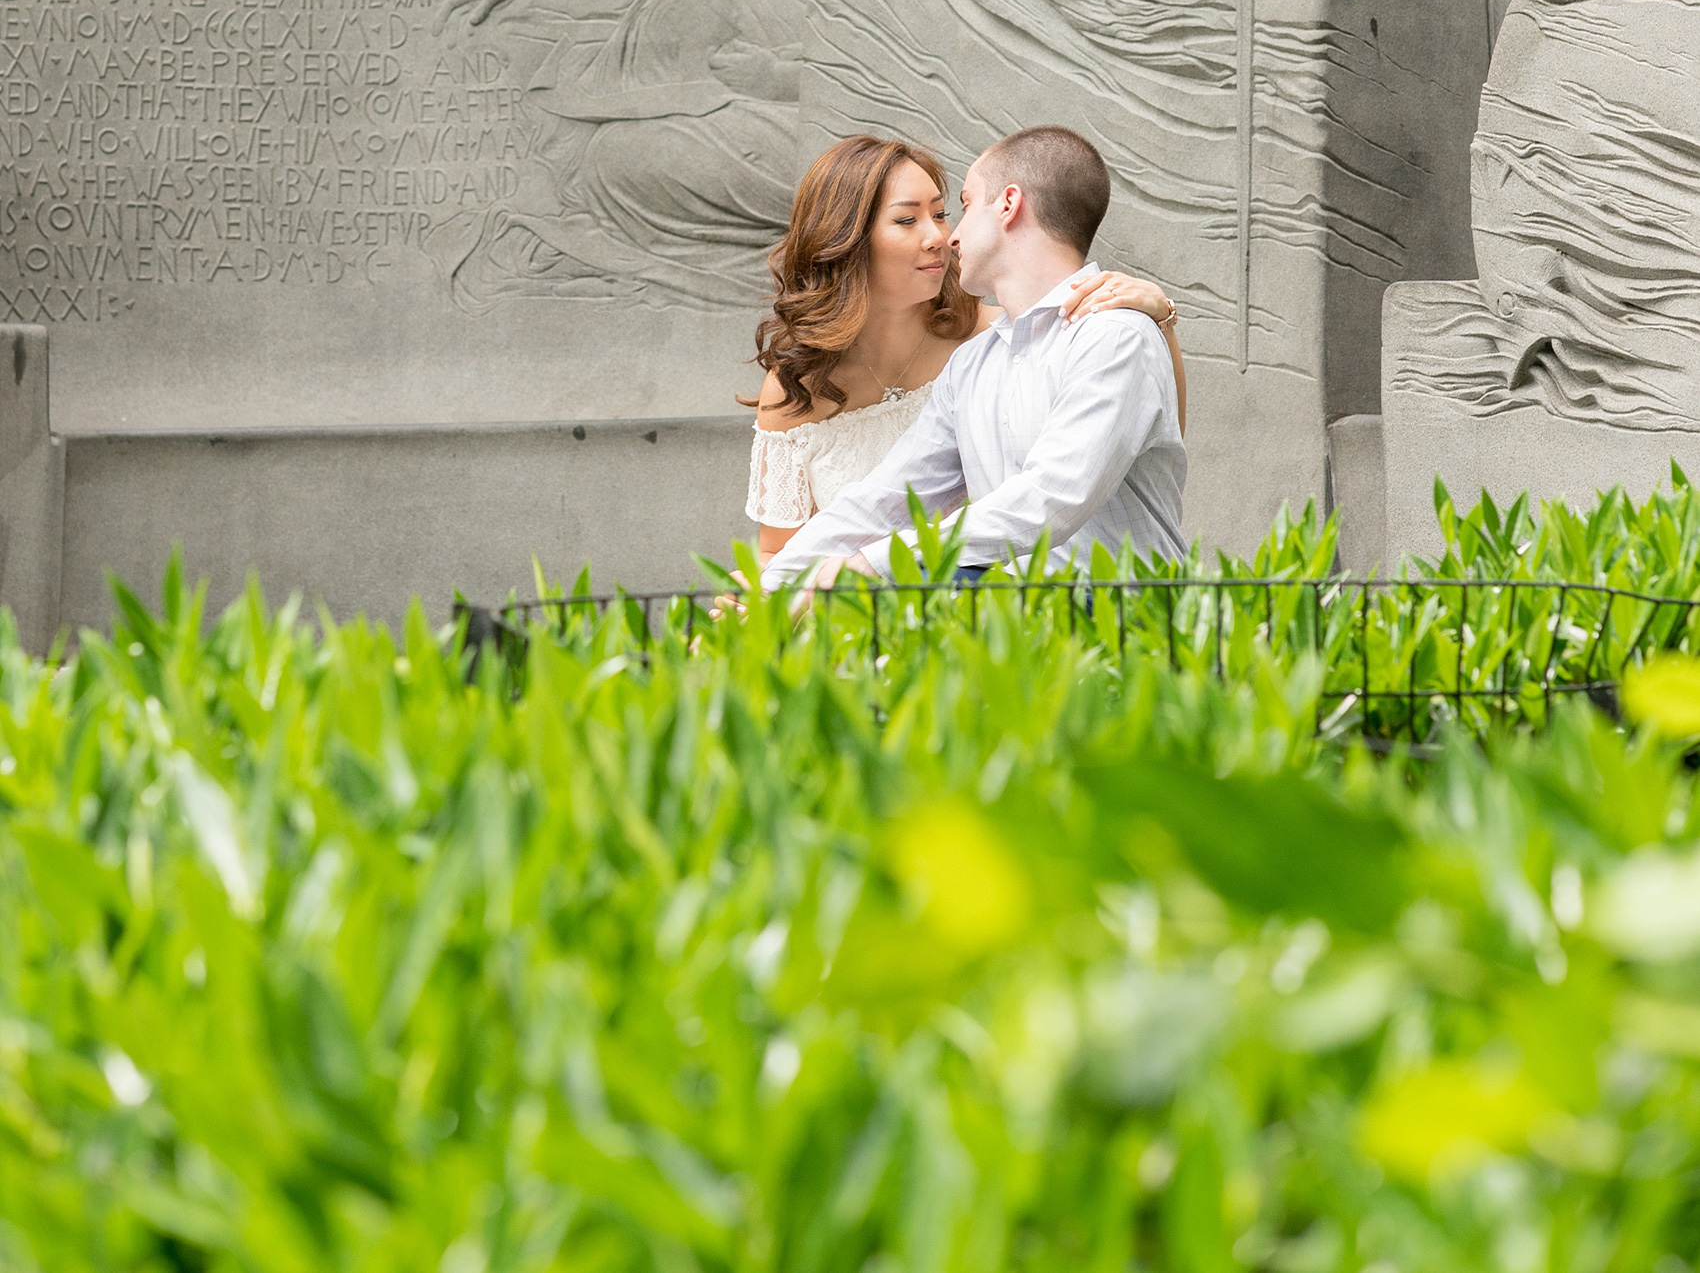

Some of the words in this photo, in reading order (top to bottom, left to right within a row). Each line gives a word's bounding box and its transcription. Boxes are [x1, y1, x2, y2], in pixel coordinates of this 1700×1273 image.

[66, 44, 150, 81] MAY
[159, 49, 196, 82] BE
[210, 50, 401, 86] PRESERVED
[428, 51, 502, 86] AND
[52, 80, 111, 121] AND
[117, 81, 195, 121] THAT
[195, 85, 276, 124] THEY
[278, 86, 351, 124] WHO
[364, 88, 436, 125] COME
[442, 87, 529, 123] AFTER
[43, 119, 120, 160] WHO
[132, 125, 208, 163] WILL
[208, 125, 272, 165] OWE
[279, 127, 343, 165] HIM
[351, 129, 387, 163] SO
[30, 159, 70, 200] AS
[80, 161, 118, 200] HE
[126, 164, 195, 201] WAS
[207, 165, 276, 205] SEEN
[283, 167, 326, 206] BY
[336, 167, 448, 207] FRIEND
[457, 164, 520, 206] AND
